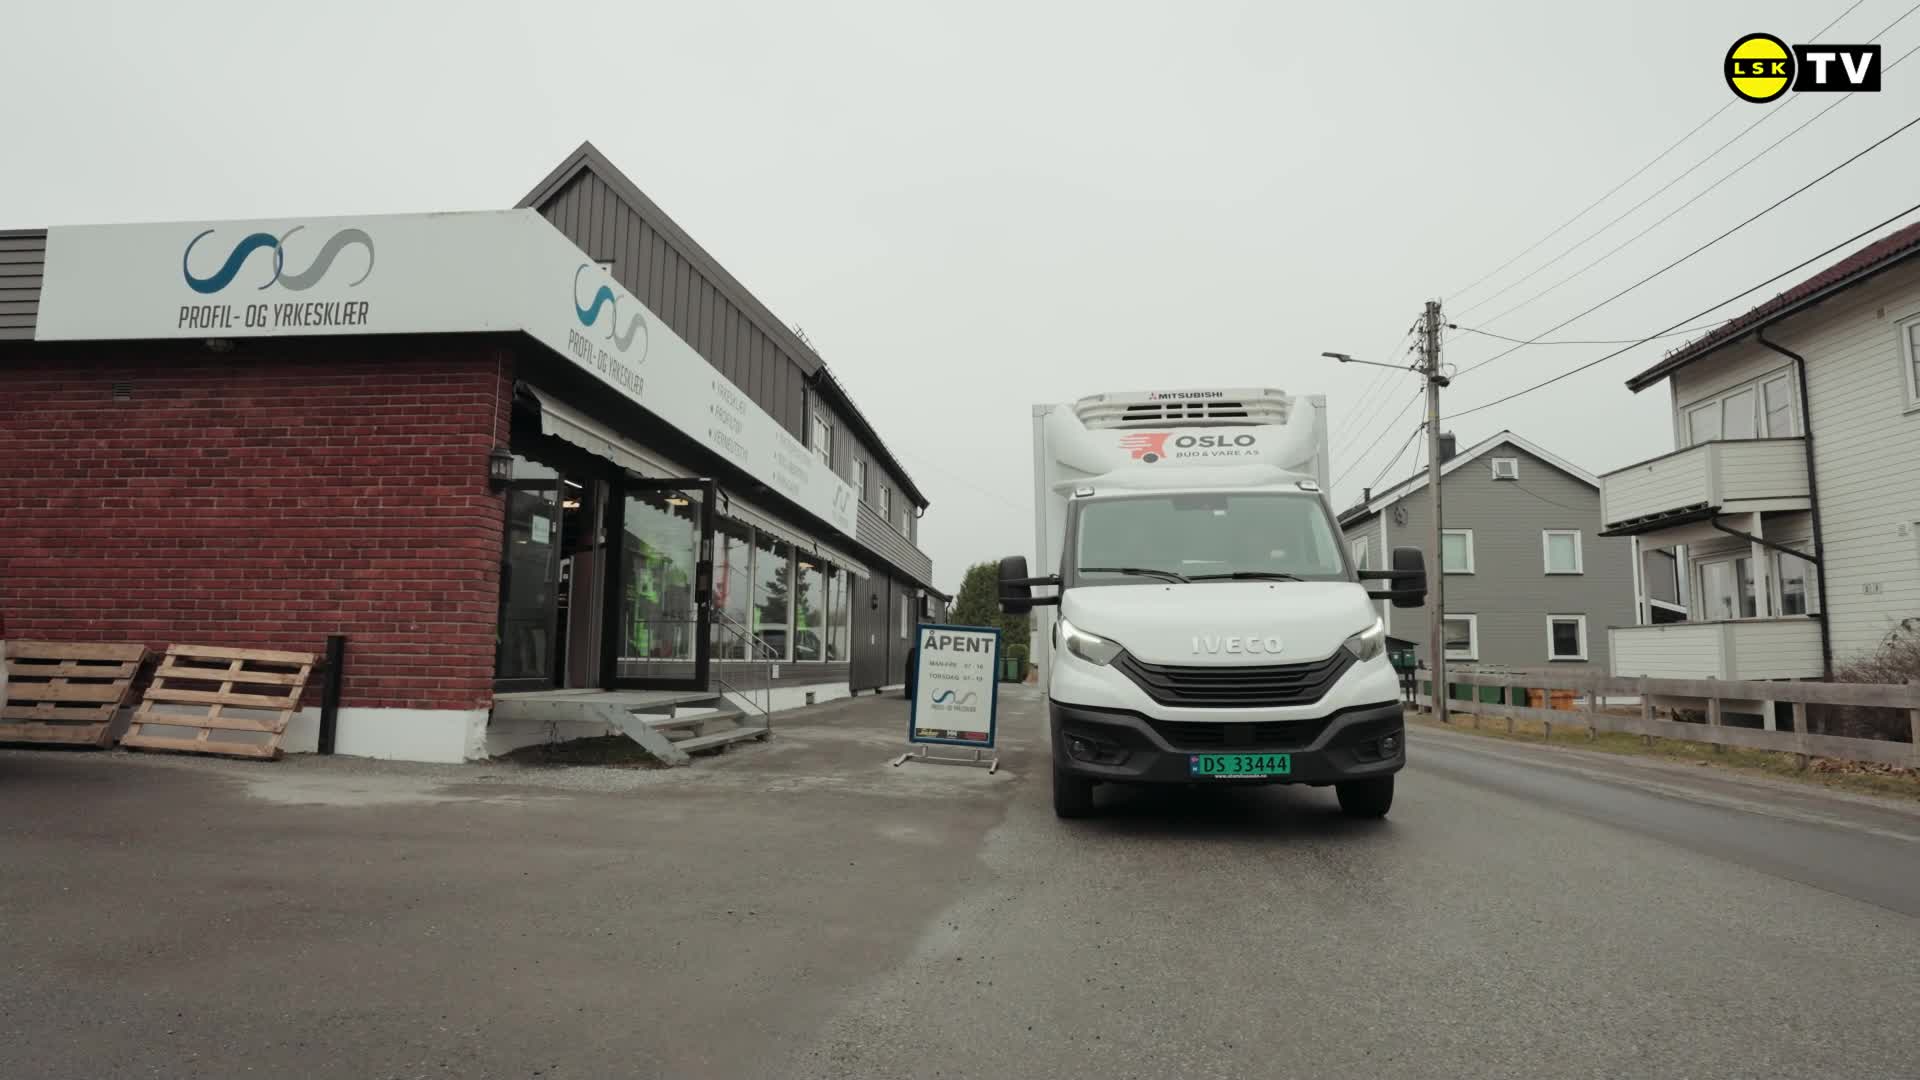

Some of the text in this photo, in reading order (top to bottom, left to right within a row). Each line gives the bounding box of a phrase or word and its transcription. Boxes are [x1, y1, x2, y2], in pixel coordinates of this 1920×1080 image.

[178, 301, 369, 329] PROFIL- OG YRKESKLÆR
[1158, 391, 1223, 400] MITSUBISHI
[1175, 434, 1256, 449] OSLO
[1176, 450, 1200, 458] BUD
[1211, 449, 1241, 457] VARE
[924, 630, 994, 653] ÅPENT
[1191, 636, 1284, 654] IVECO
[1204, 757, 1287, 772] DS 33444
